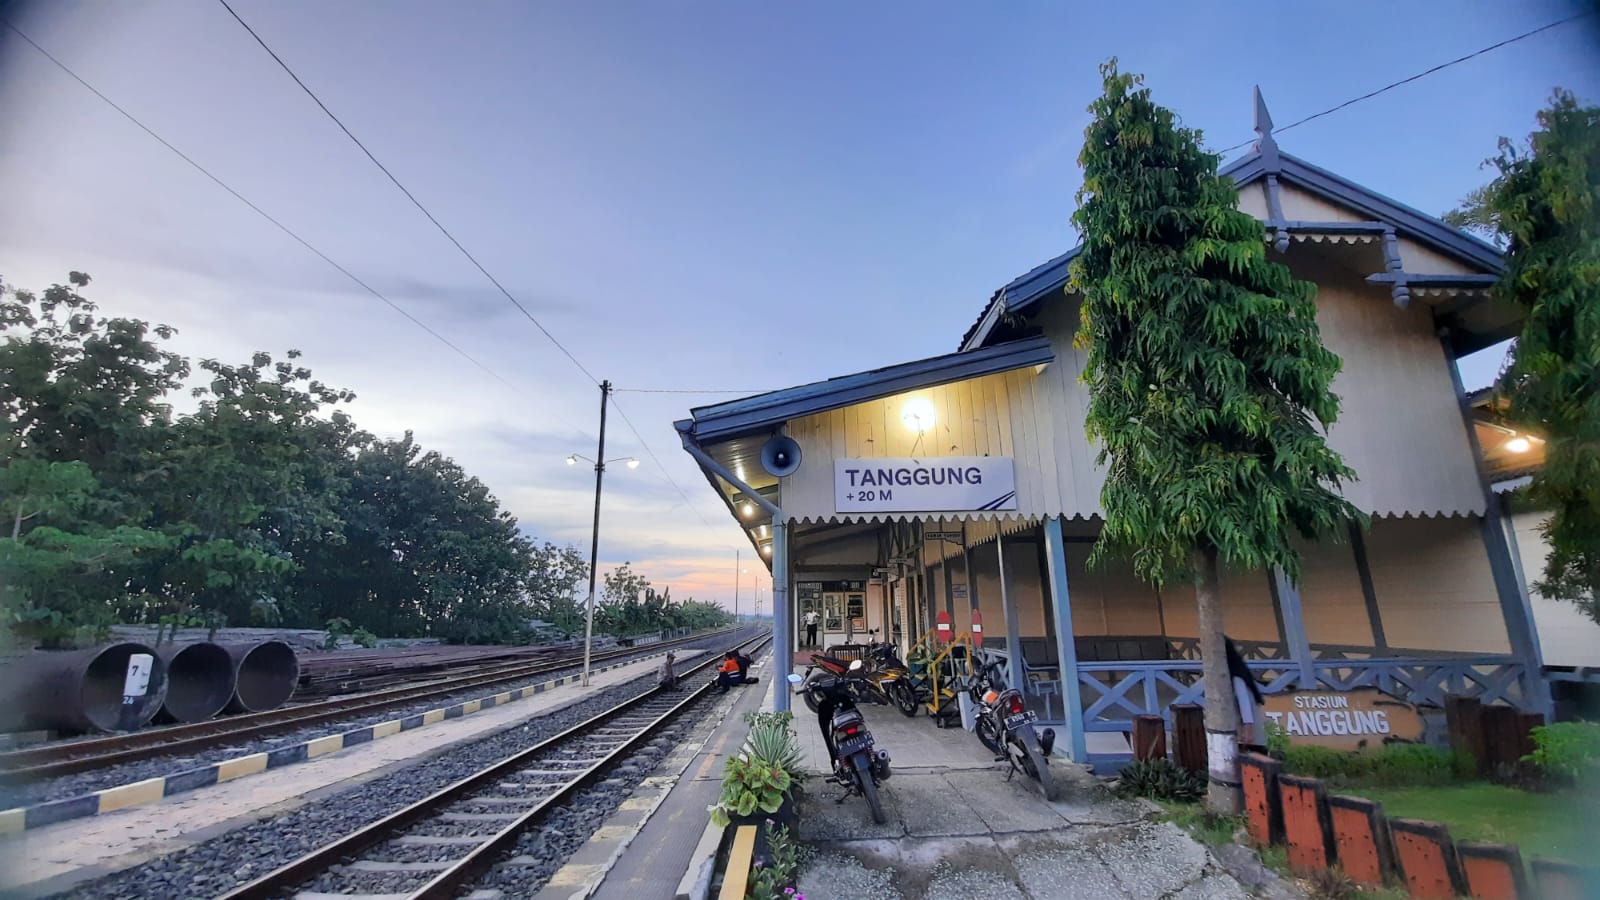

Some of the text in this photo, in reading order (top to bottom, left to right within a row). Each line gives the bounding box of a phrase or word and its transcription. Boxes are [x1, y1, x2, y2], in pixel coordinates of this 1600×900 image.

[845, 467, 982, 486] TANGGUNG
[858, 491, 875, 502] 20
[879, 490, 892, 501] M
[132, 665, 139, 676] 7
[1294, 695, 1349, 709] STASIUN
[1265, 710, 1390, 736] TANGGUNG
